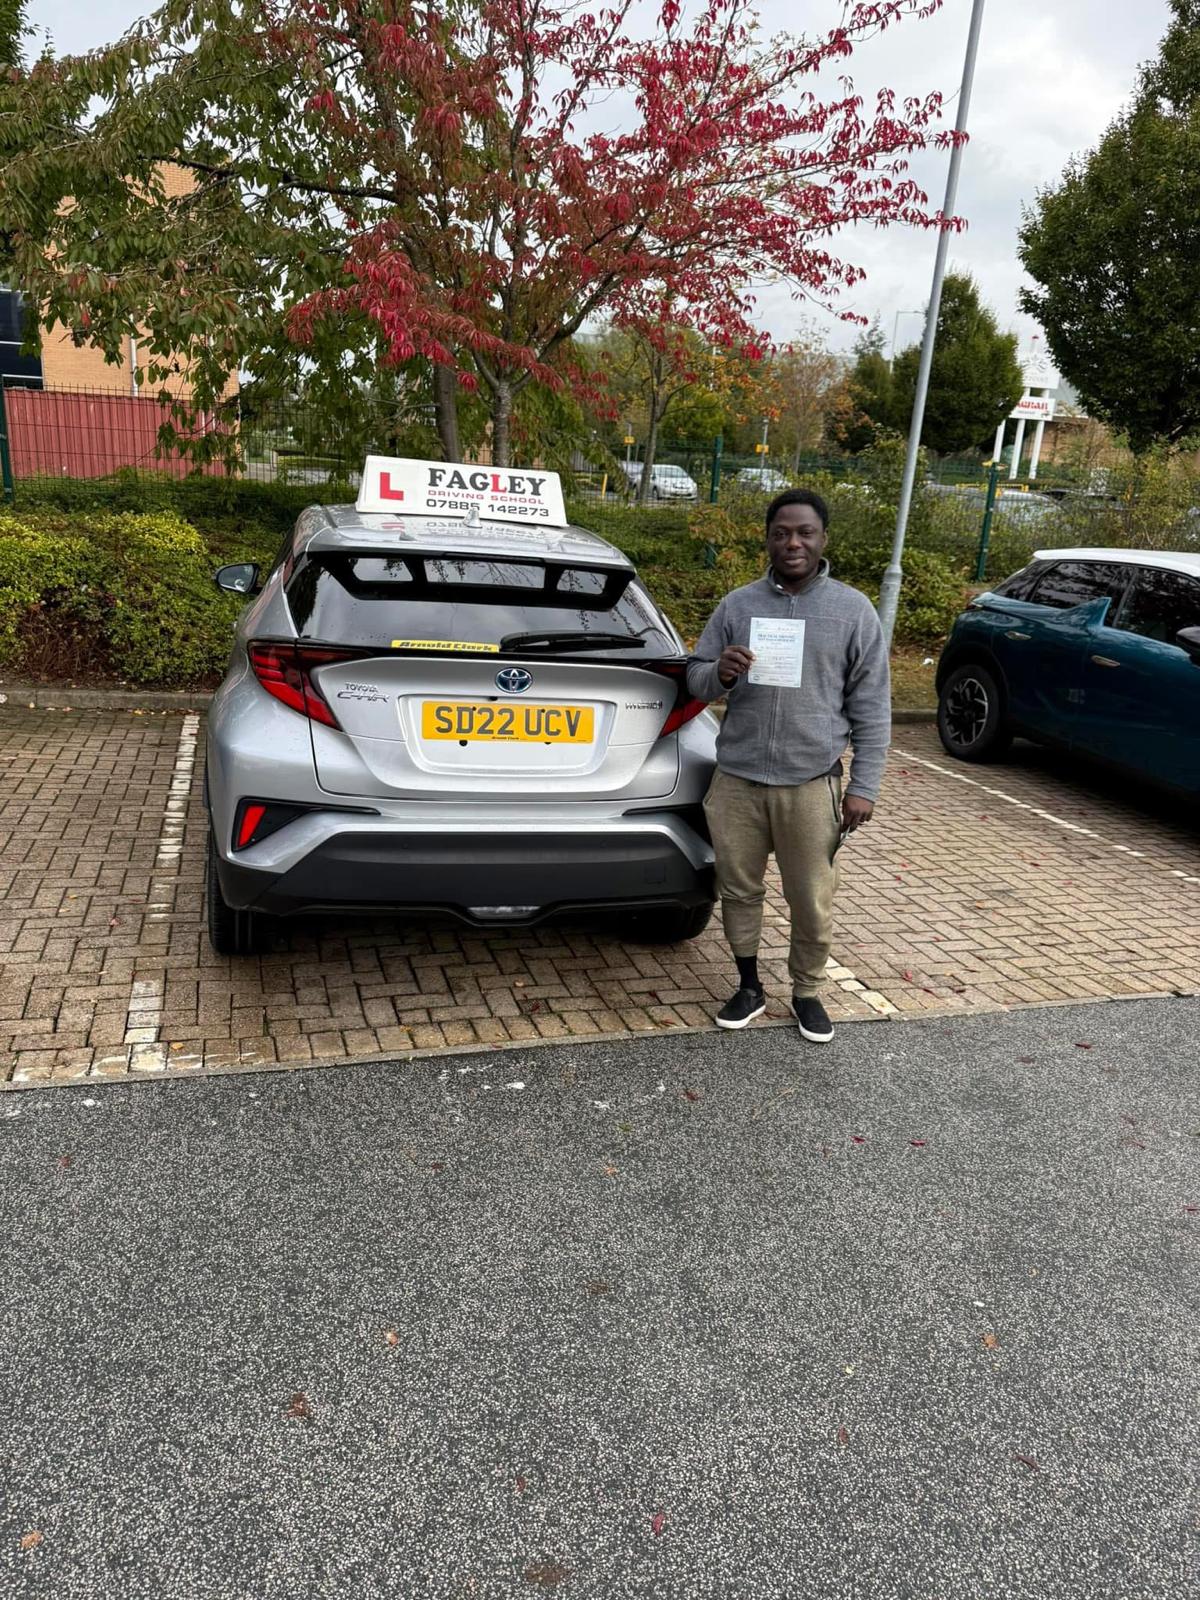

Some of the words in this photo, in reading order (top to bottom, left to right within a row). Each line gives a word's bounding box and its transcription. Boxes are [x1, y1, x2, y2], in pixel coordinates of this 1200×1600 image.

[379, 471, 405, 502] L
[428, 467, 547, 497] FAGLEY
[428, 489, 485, 501] DRIVING
[490, 495, 545, 506] SCHOOL
[426, 498, 481, 512] 07885
[488, 503, 550, 518] 142273
[400, 641, 451, 649] Arnold
[453, 643, 492, 652] Clark
[345, 683, 379, 693] TOYOTA
[434, 704, 515, 735] SD22
[524, 708, 583, 738] UCV
